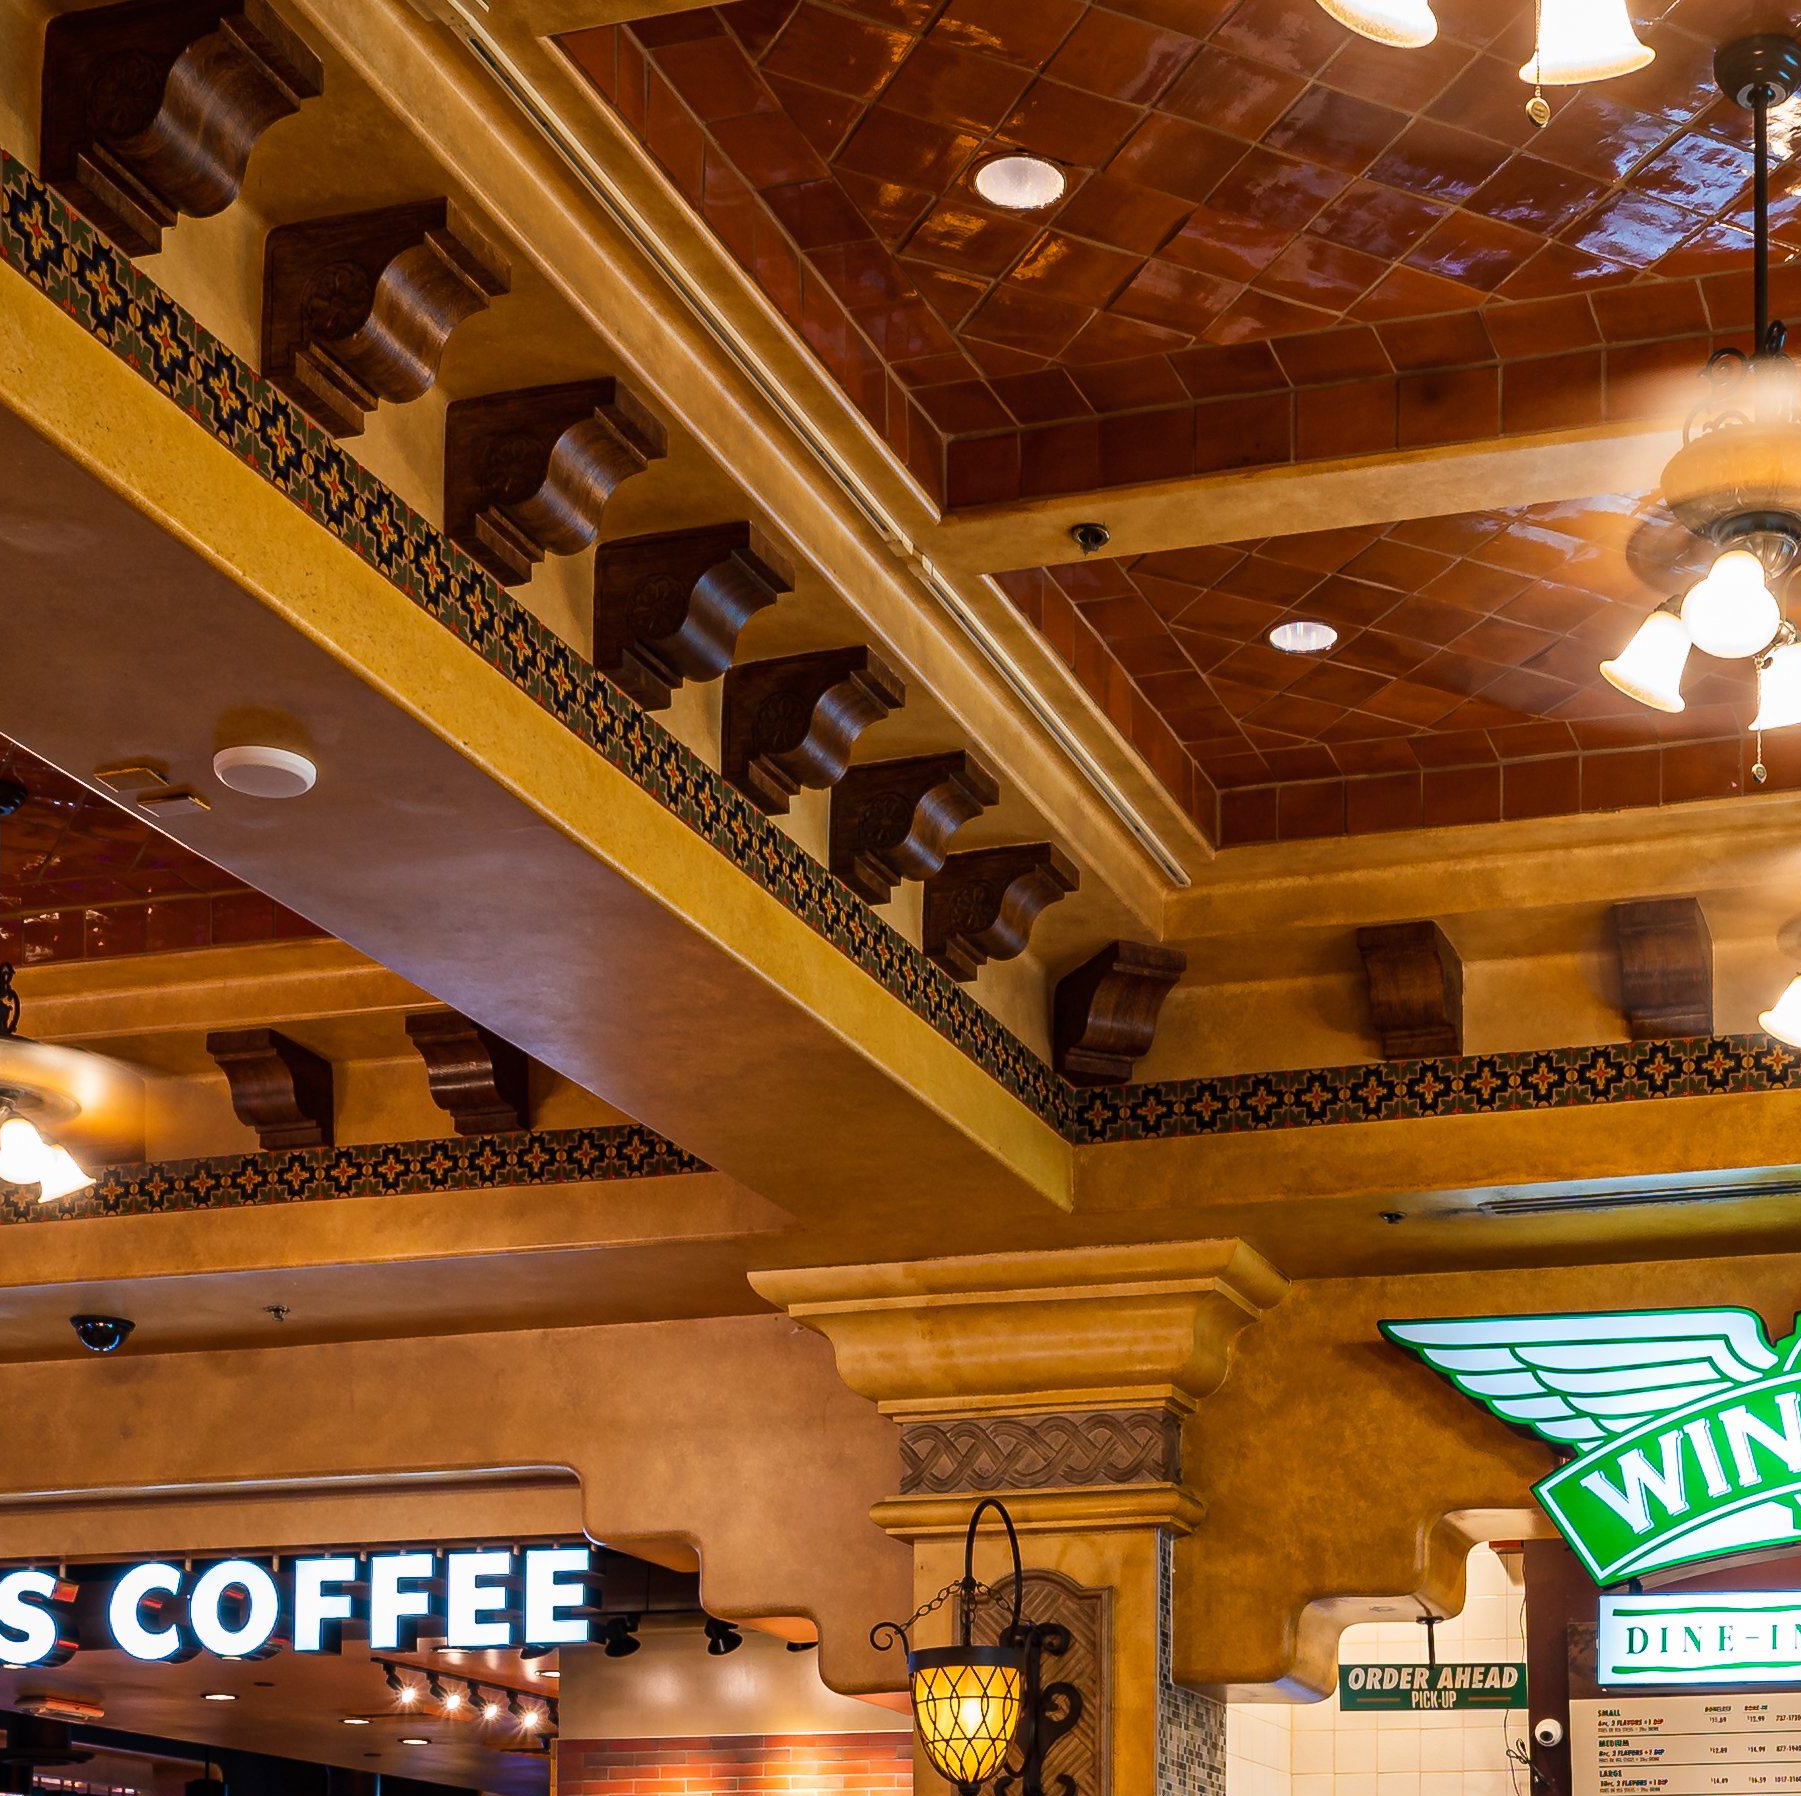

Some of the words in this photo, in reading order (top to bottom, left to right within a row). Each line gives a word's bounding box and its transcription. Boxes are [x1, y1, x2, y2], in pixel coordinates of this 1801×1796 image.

[108, 1548, 590, 1662] COFFEE
[1348, 1667, 1430, 1690] ORDER
[1437, 1666, 1519, 1689] AHEAD
[1411, 1690, 1457, 1708] PICK-UP
[1598, 1709, 1620, 1717] SMALL
